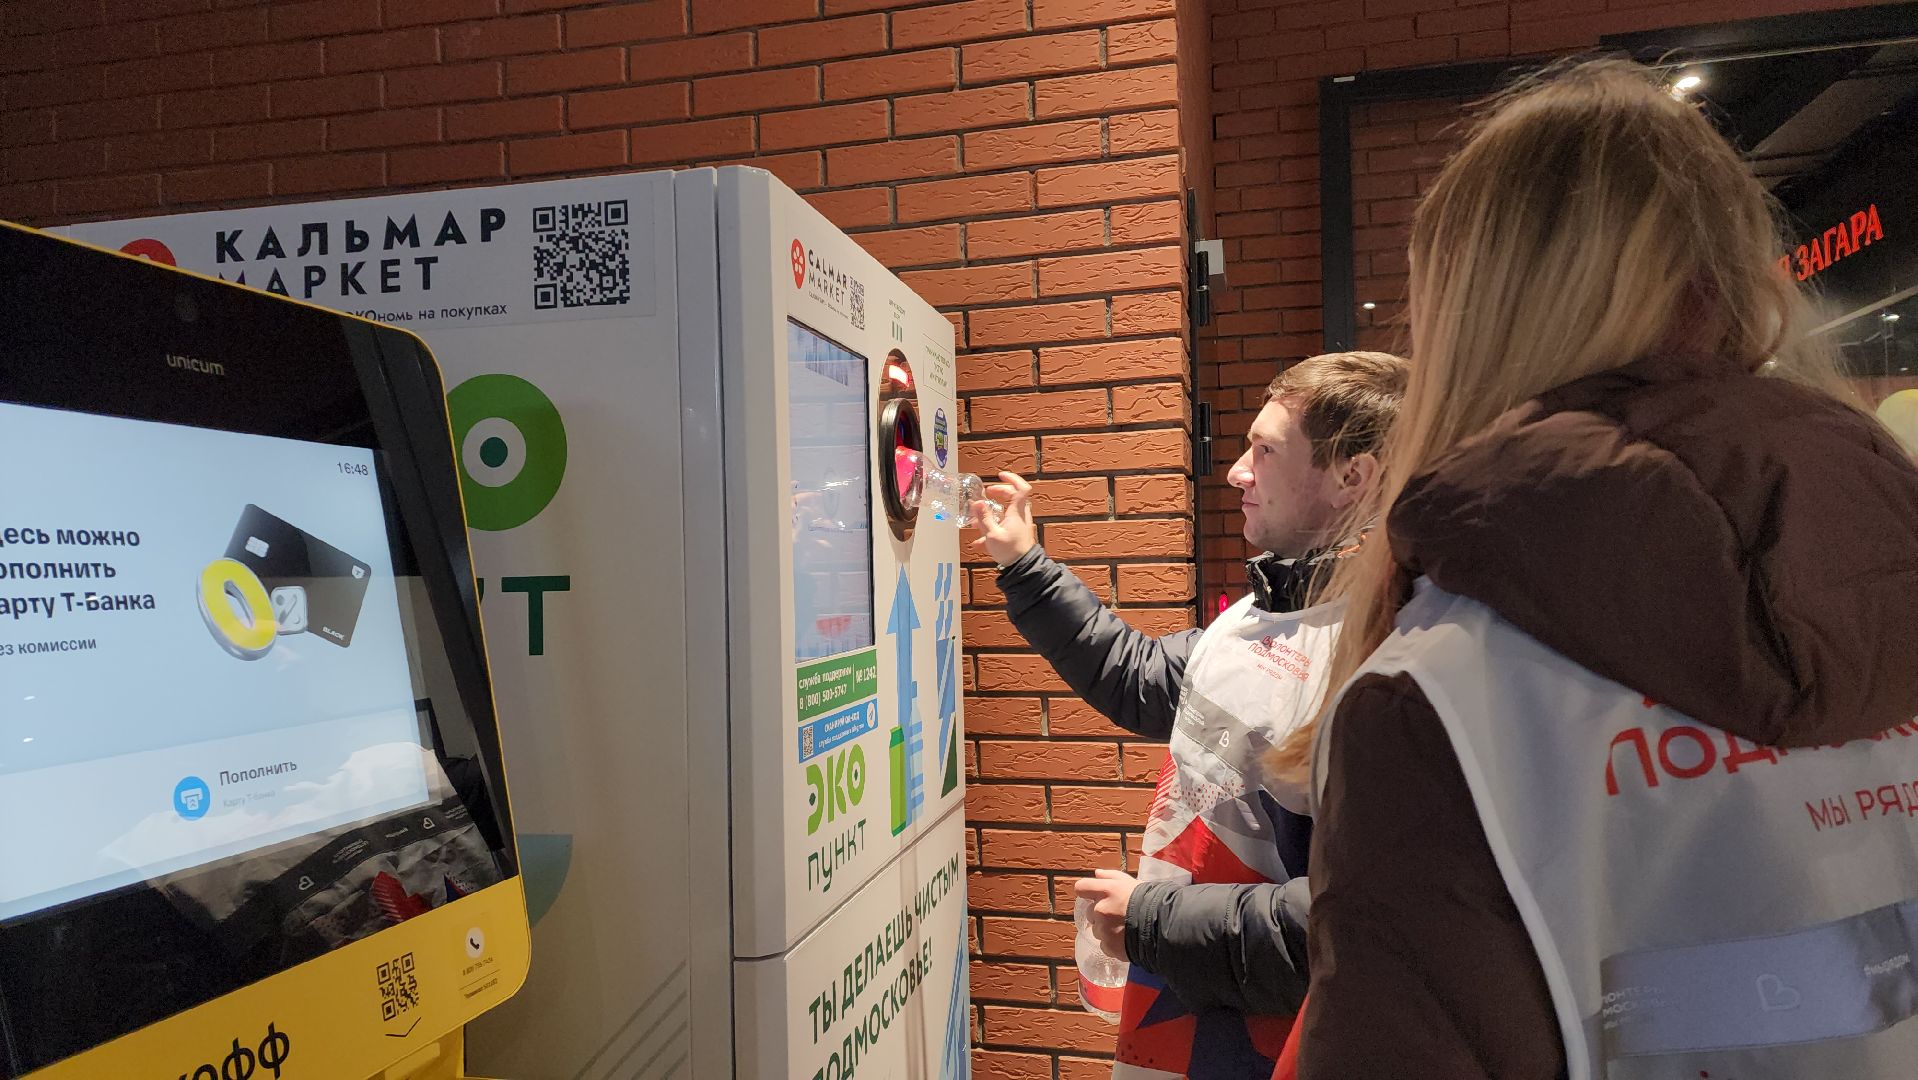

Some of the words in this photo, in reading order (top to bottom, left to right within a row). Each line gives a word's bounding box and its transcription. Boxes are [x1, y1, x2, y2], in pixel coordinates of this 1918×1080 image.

[215, 207, 506, 264] КАЛЬМАР
[1796, 203, 1884, 281] ЗАГАРА
[808, 248, 848, 289] CALMAR
[808, 268, 845, 306] MARKET
[418, 308, 437, 320] на
[440, 303, 507, 322] покупках
[166, 353, 225, 376] unicum
[337, 461, 369, 476] 16:48
[56, 528, 140, 547] можно
[60, 591, 156, 612] Т-Банка
[18, 638, 97, 655] комиссии
[322, 626, 345, 641] BLACK
[219, 761, 298, 787] Пополнить
[805, 743, 866, 837] ЭКО
[1805, 794, 1852, 832] МЫ
[808, 979, 837, 1046] ТЫ
[841, 904, 913, 1020] ДЕЛАЕШЬ
[914, 851, 959, 925] ЧИСТЫМ
